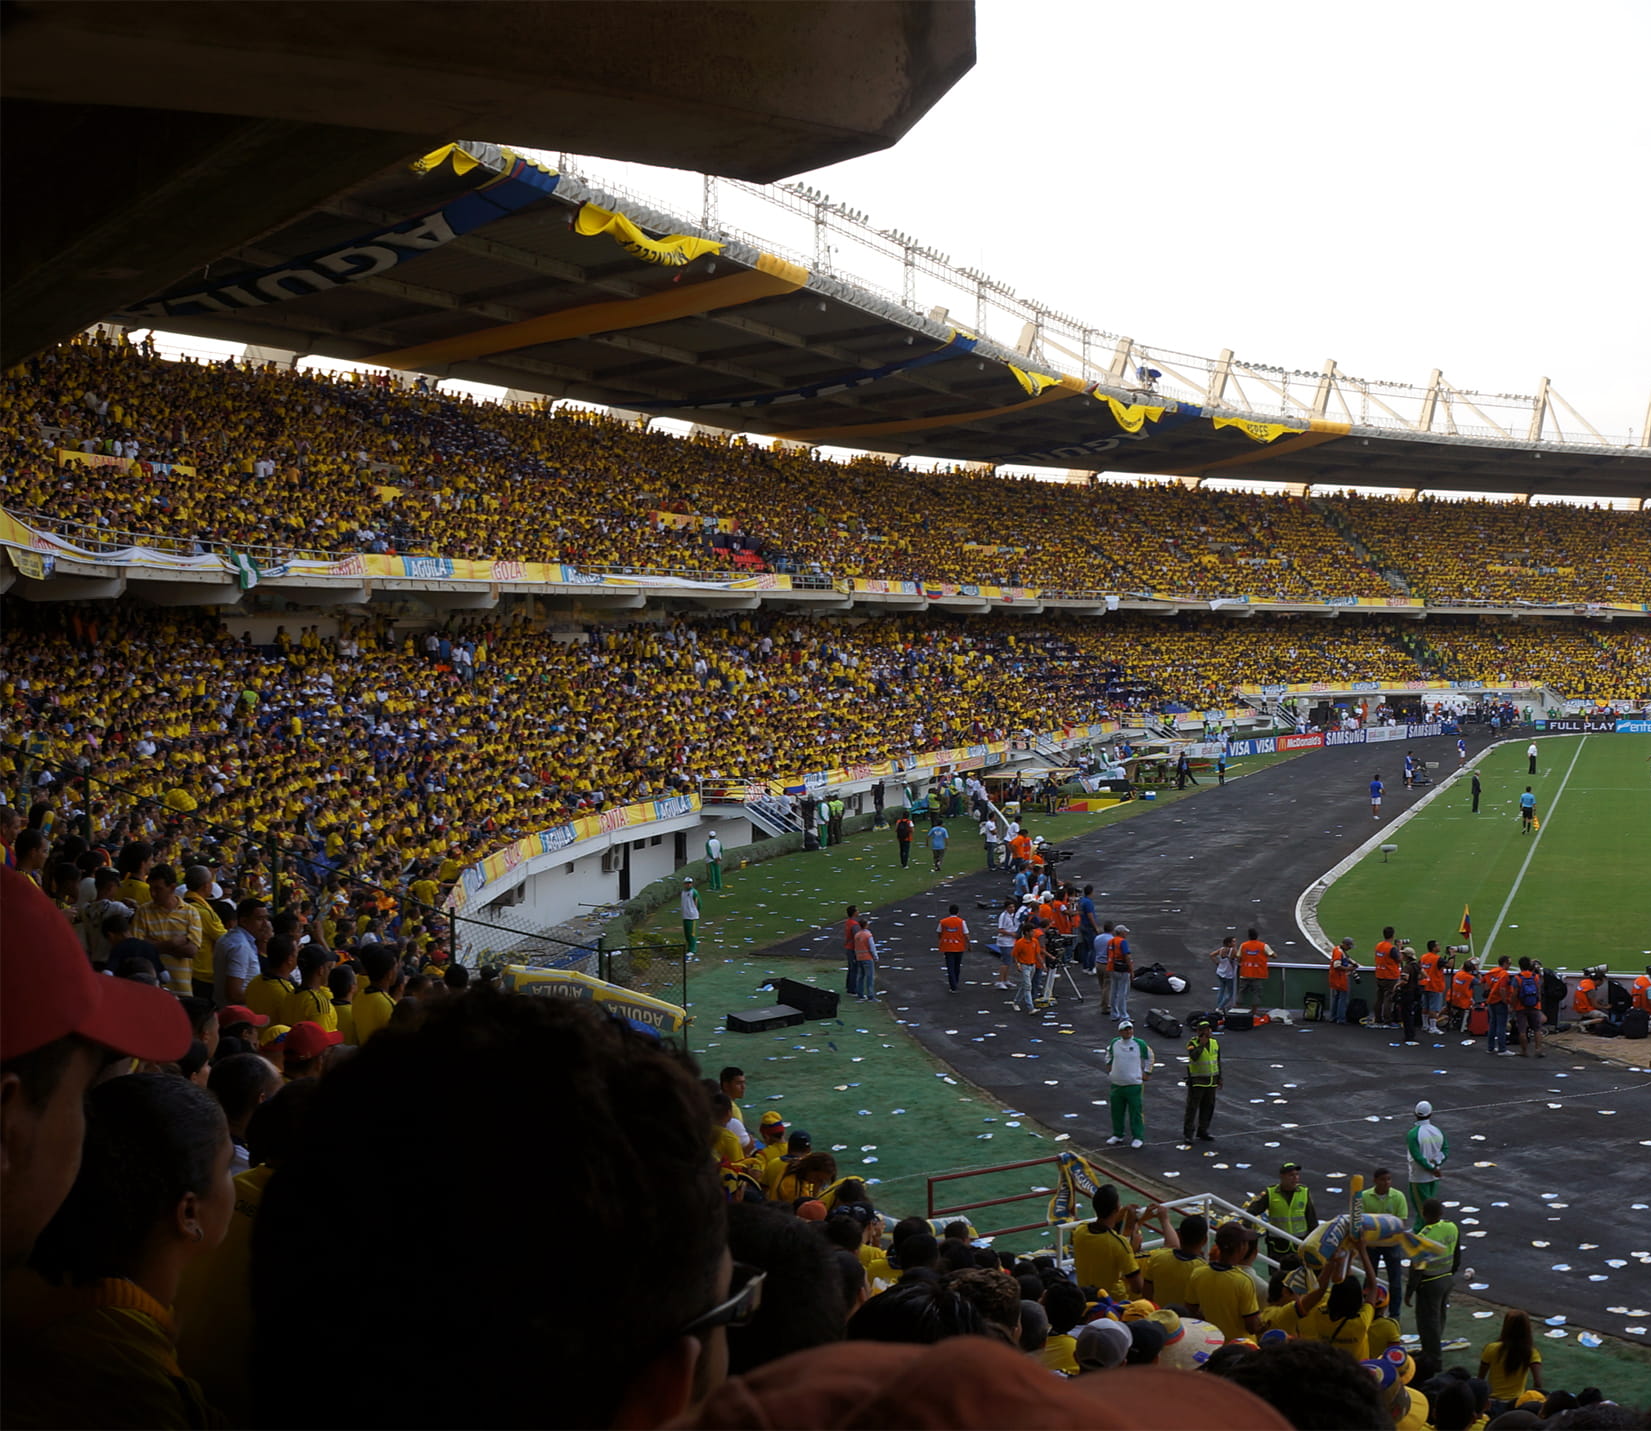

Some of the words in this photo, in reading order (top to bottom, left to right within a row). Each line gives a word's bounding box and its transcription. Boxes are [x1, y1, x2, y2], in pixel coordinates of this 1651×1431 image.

[411, 559, 447, 577] AGUILA
[1408, 722, 1442, 739] SAMSUNG
[1550, 722, 1582, 730] FULL
[1584, 722, 1615, 730] PLAY
[1256, 737, 1275, 754] VISA
[1286, 735, 1322, 749] McDonald's
[1326, 727, 1366, 747] SAMSUNG
[1229, 739, 1251, 756] VISA
[661, 798, 691, 821] AGUILA
[608, 1002, 664, 1028] AGUILA
